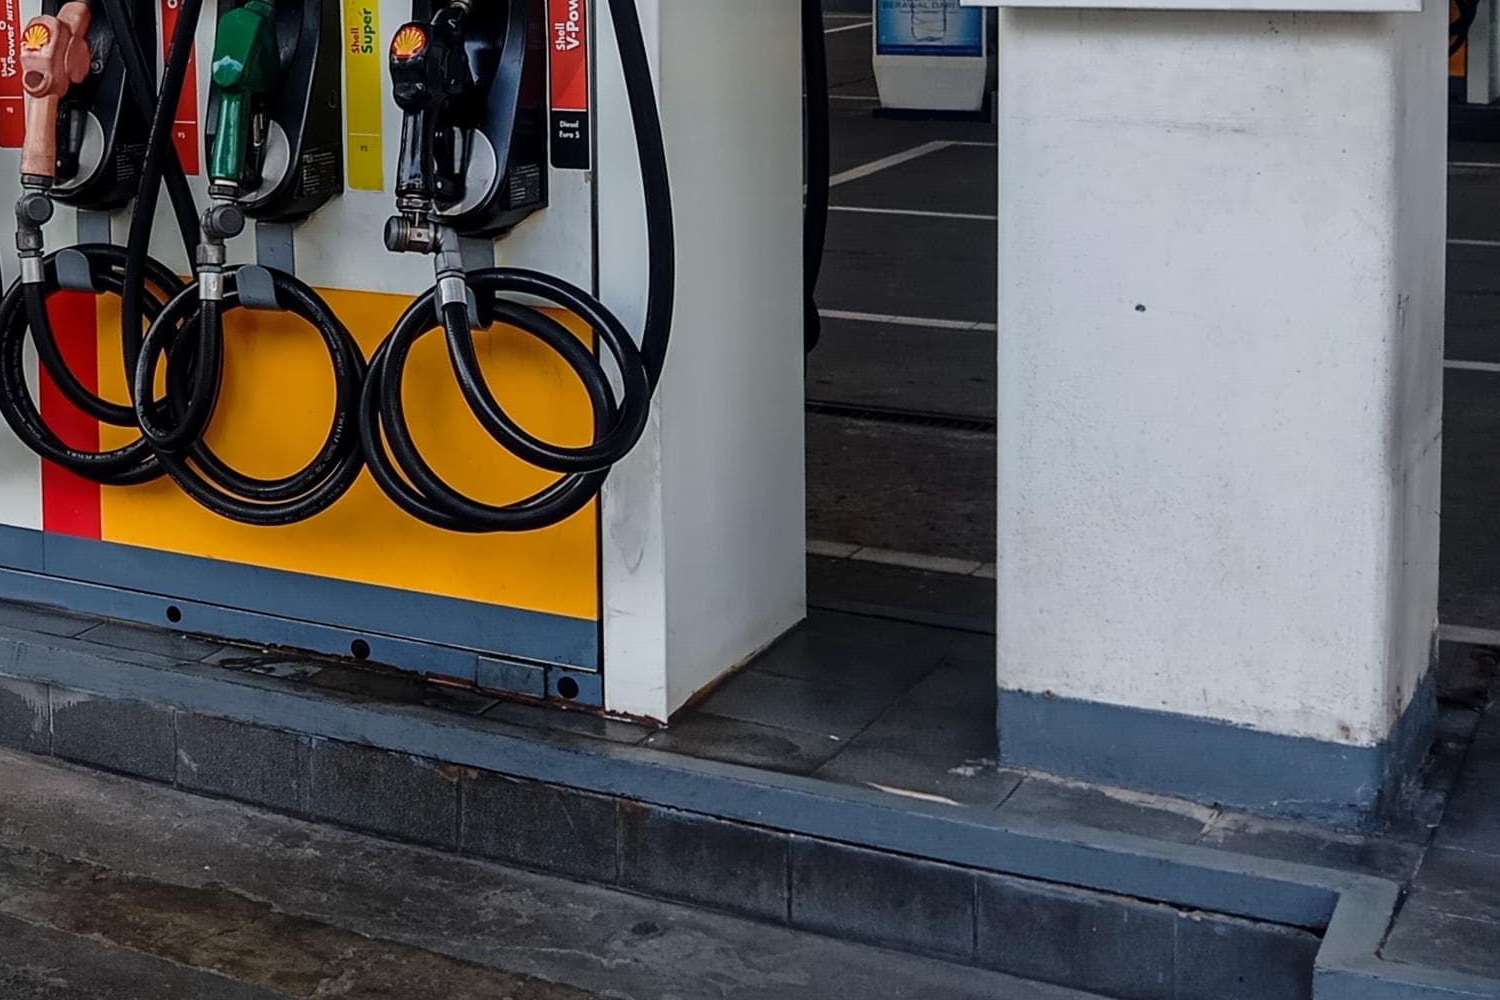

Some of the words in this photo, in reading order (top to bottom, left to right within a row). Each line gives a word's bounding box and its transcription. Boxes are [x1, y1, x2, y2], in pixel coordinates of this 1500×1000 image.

[350, 27, 359, 53] Shell
[361, 8, 375, 53] Super
[556, 23, 565, 51] Shell
[7, 24, 16, 77] V-Power
[559, 120, 579, 128] Diesel
